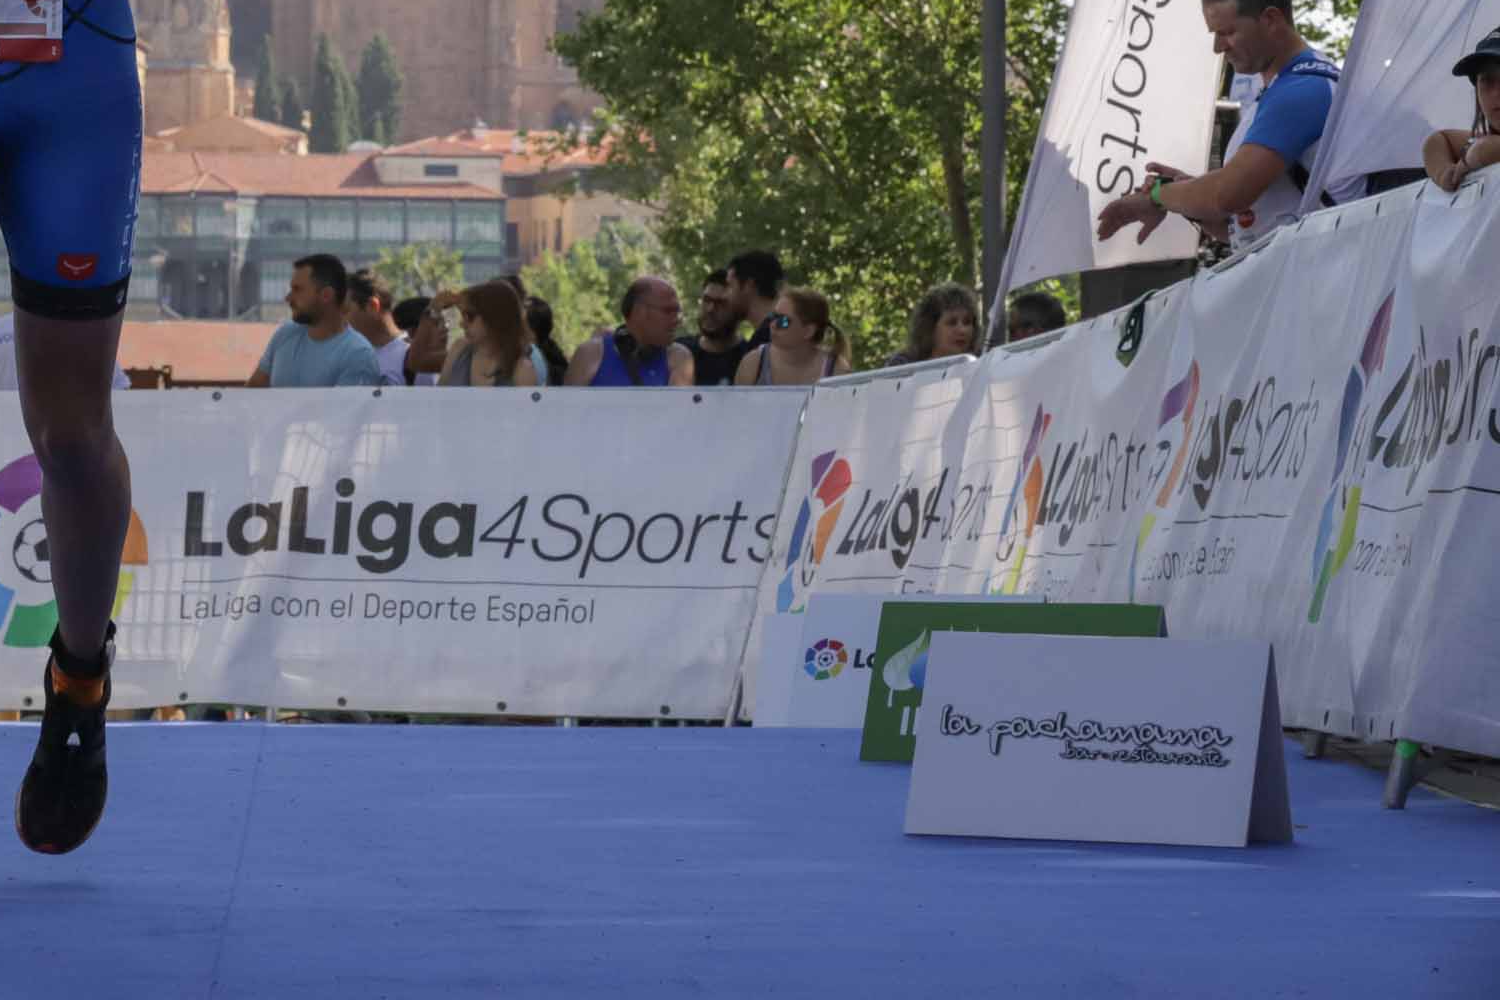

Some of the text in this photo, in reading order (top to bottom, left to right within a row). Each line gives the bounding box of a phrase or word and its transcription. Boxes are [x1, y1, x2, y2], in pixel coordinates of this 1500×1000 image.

[184, 477, 775, 579] LaLiga4Sports
[179, 592, 596, 628] LaLiga con el Deporte Español
[940, 703, 983, 737] la
[988, 712, 1233, 755] pachamama
